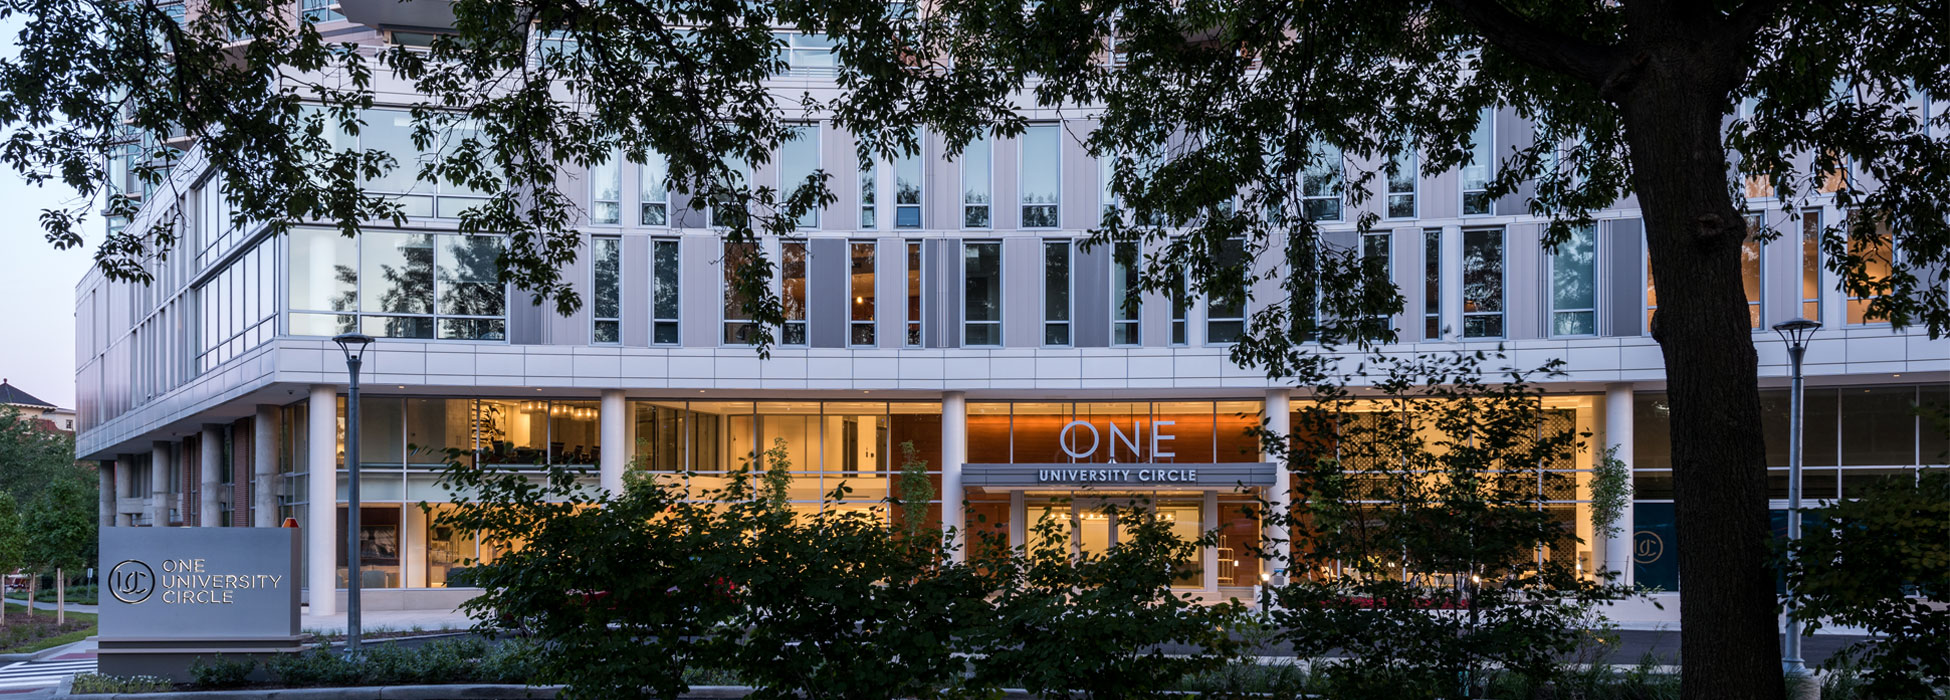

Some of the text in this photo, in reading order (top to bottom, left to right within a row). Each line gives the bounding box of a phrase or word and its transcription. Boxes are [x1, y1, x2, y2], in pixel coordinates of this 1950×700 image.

[1060, 420, 1175, 458] ONE
[1039, 469, 1196, 482] UNIVERSITY CIRCLE
[161, 558, 206, 573] ONE
[161, 574, 282, 589] UNIVERSITY
[161, 589, 234, 604] CIRCLE
